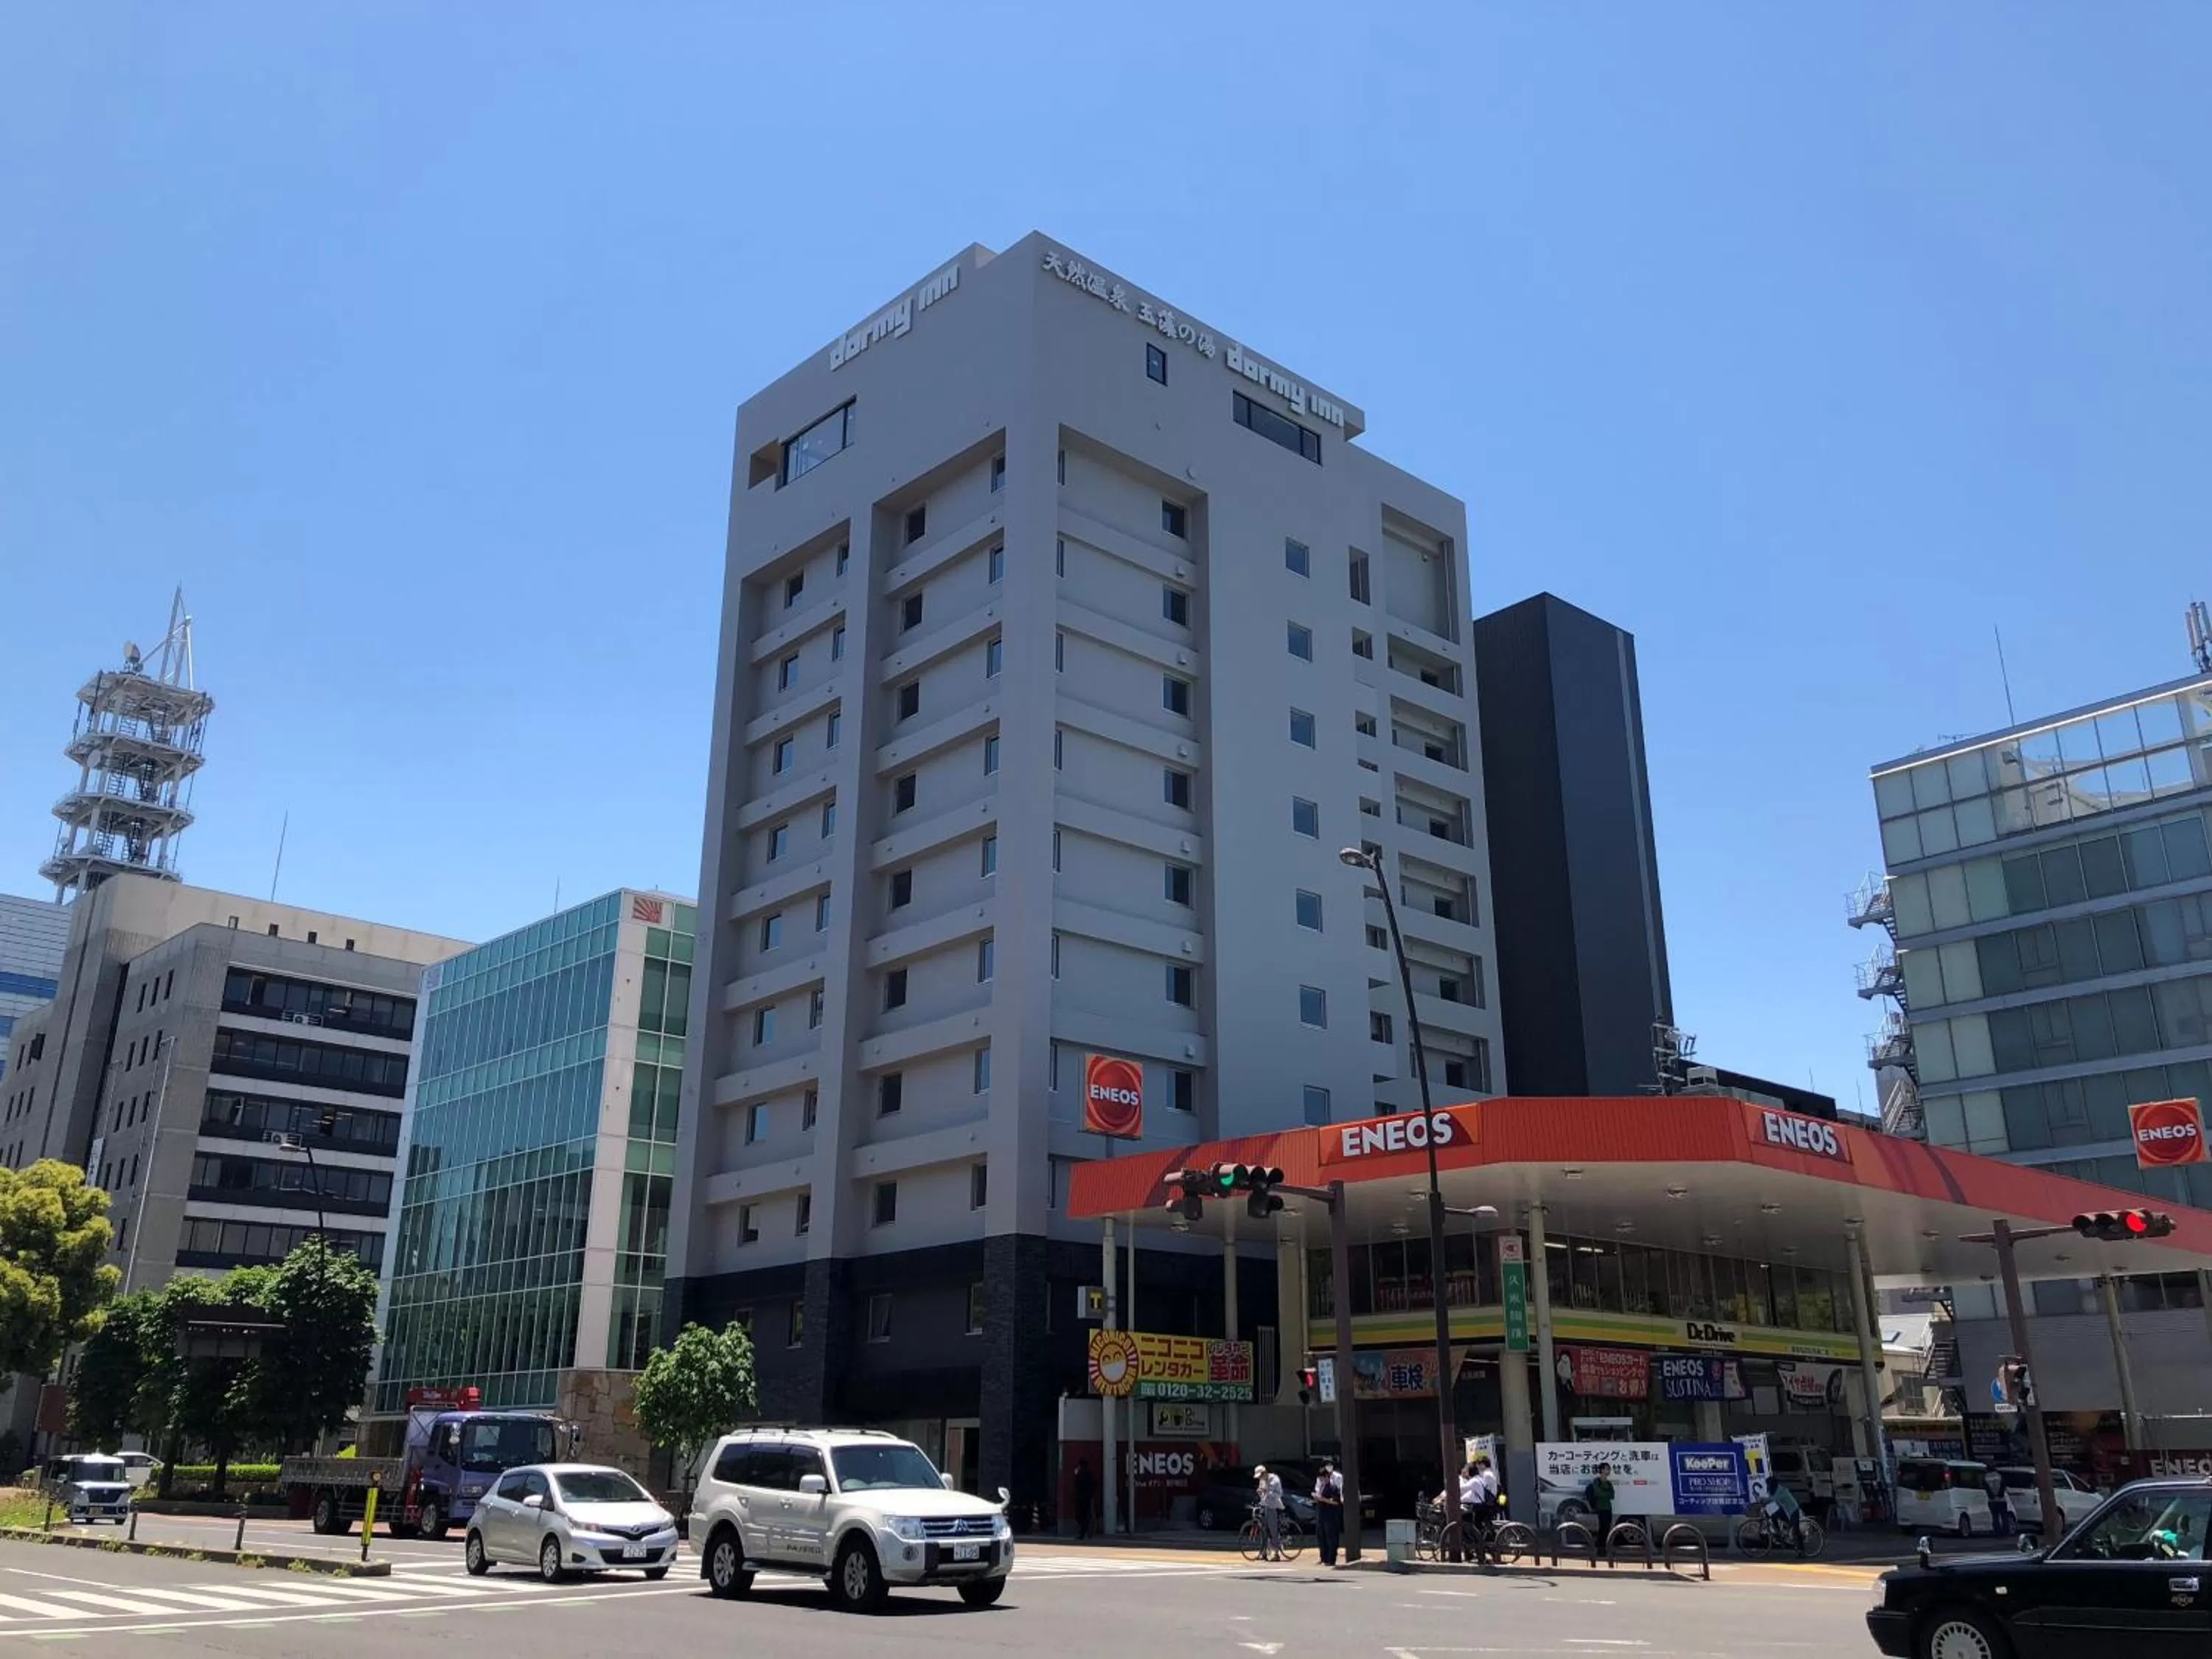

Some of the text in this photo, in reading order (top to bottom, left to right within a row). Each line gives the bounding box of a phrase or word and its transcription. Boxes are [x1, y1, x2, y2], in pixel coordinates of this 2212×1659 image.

[1041, 251, 1216, 360] 天然温泉 玉藻の湯
[830, 265, 959, 372] dormy inn
[1225, 343, 1344, 428] dormy inn
[1090, 1085, 1139, 1106] ENEOS
[1341, 1112, 1453, 1157] ENEOS
[1763, 1111, 1837, 1155] ENEOS
[2138, 1123, 2197, 1141] ENEOS
[1140, 1335, 1204, 1360] ニコニコ
[1141, 1359, 1204, 1378] レンタカー
[1390, 1363, 1425, 1391] 車検
[1663, 1359, 1704, 1377] ENEOS
[1665, 1378, 1711, 1399] SUSTINA
[1548, 1450, 1659, 1461] カーコーティングと洗車は
[1548, 1464, 1639, 1475] 当店におませを。
